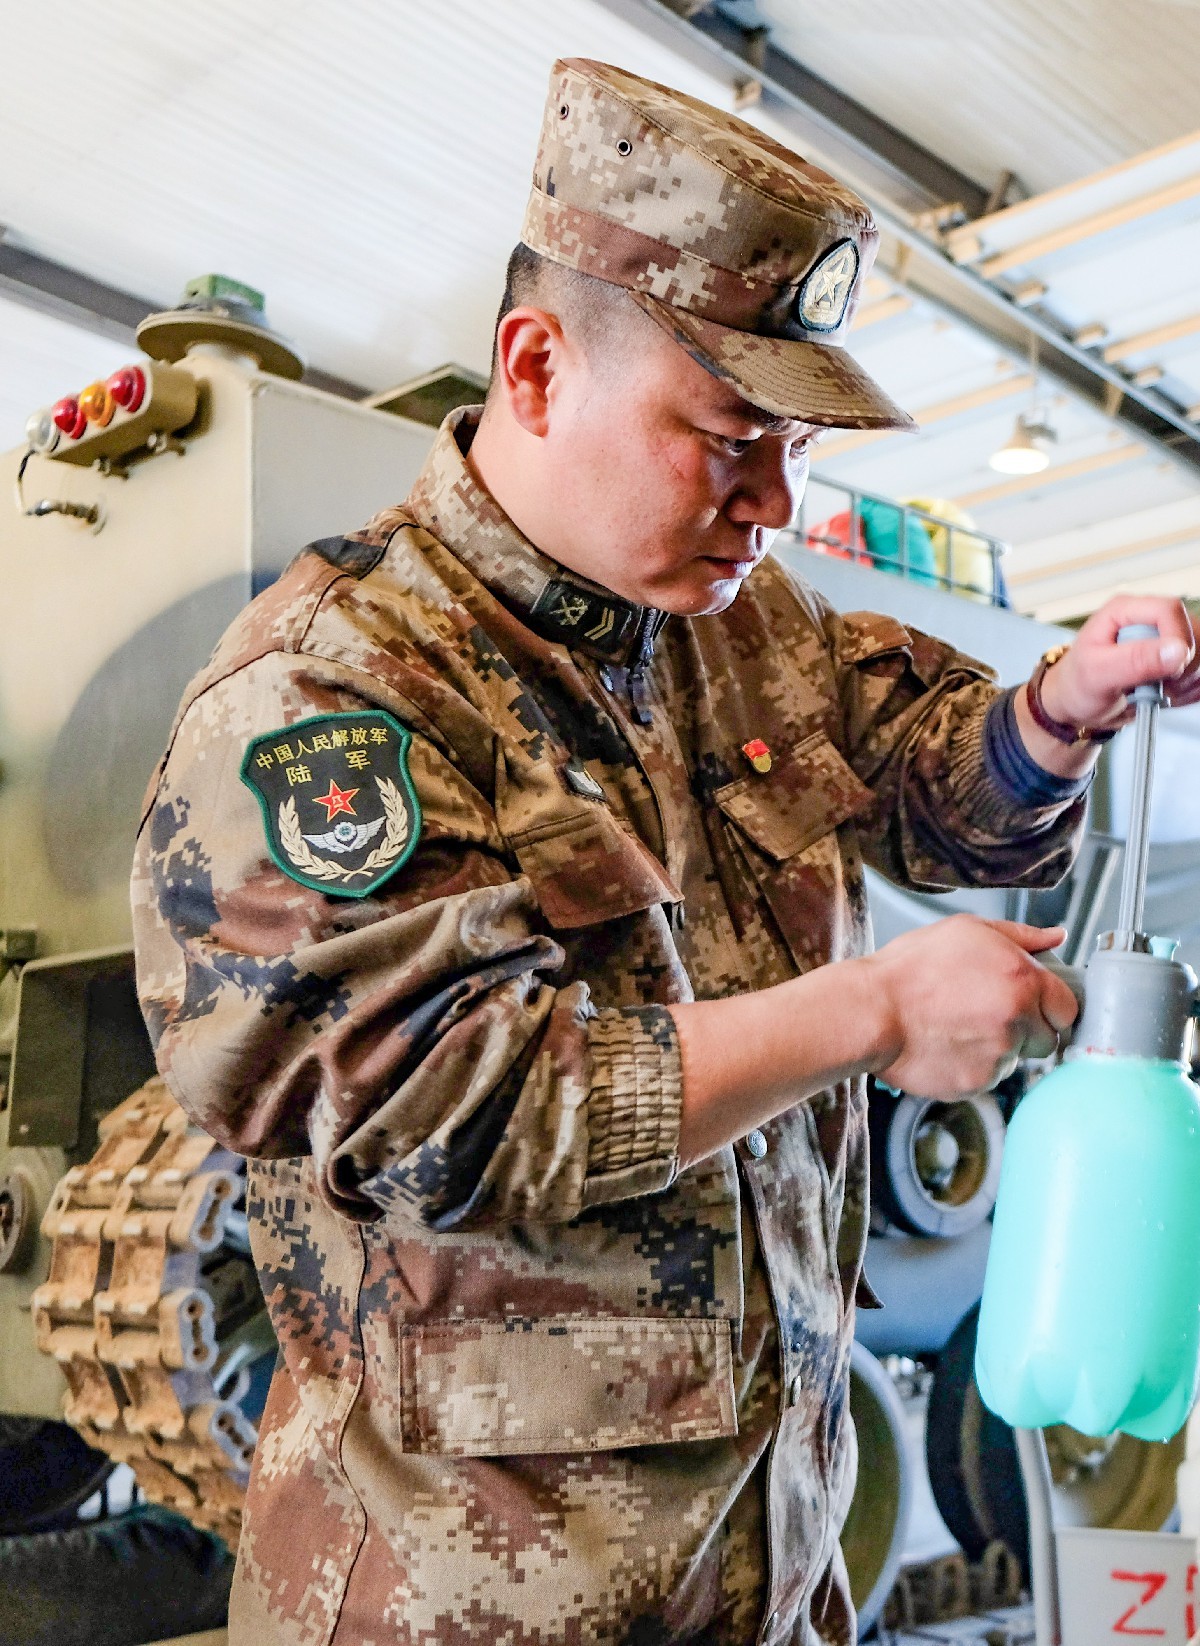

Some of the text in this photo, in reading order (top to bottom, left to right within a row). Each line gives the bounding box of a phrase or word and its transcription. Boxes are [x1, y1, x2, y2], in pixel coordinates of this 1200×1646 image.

[256, 726, 389, 771] 中国人民解放军
[285, 749, 372, 787] 陆 军
